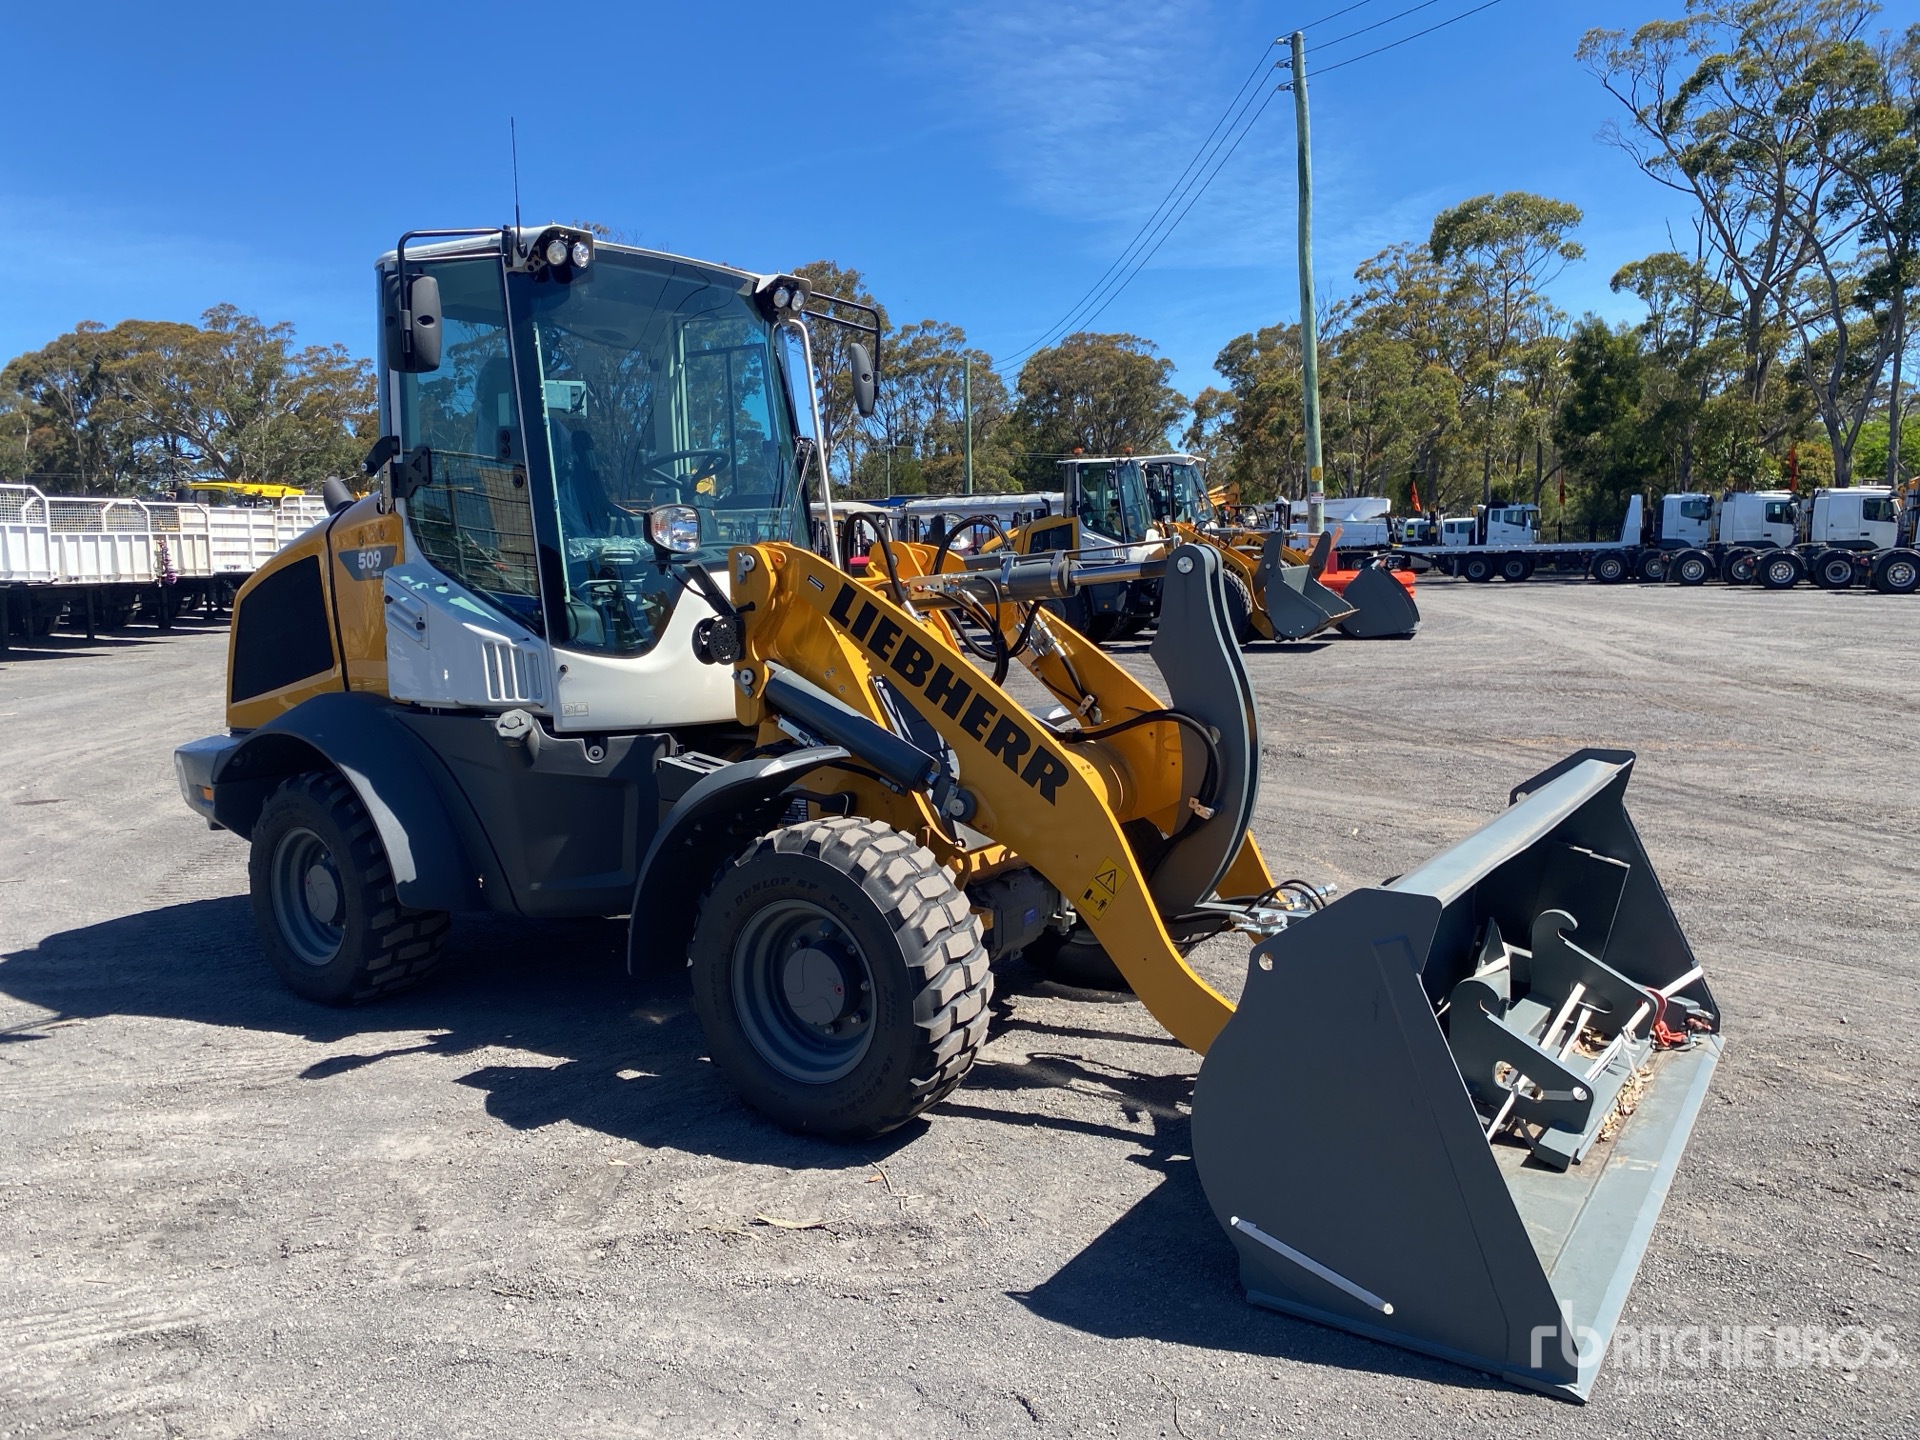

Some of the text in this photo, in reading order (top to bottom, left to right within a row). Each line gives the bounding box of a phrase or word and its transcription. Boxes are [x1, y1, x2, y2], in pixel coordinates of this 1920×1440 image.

[357, 550, 382, 570] 509
[829, 583, 1069, 806] LIEBHERR
[734, 876, 791, 906] DUNLOP
[796, 878, 819, 890] SP
